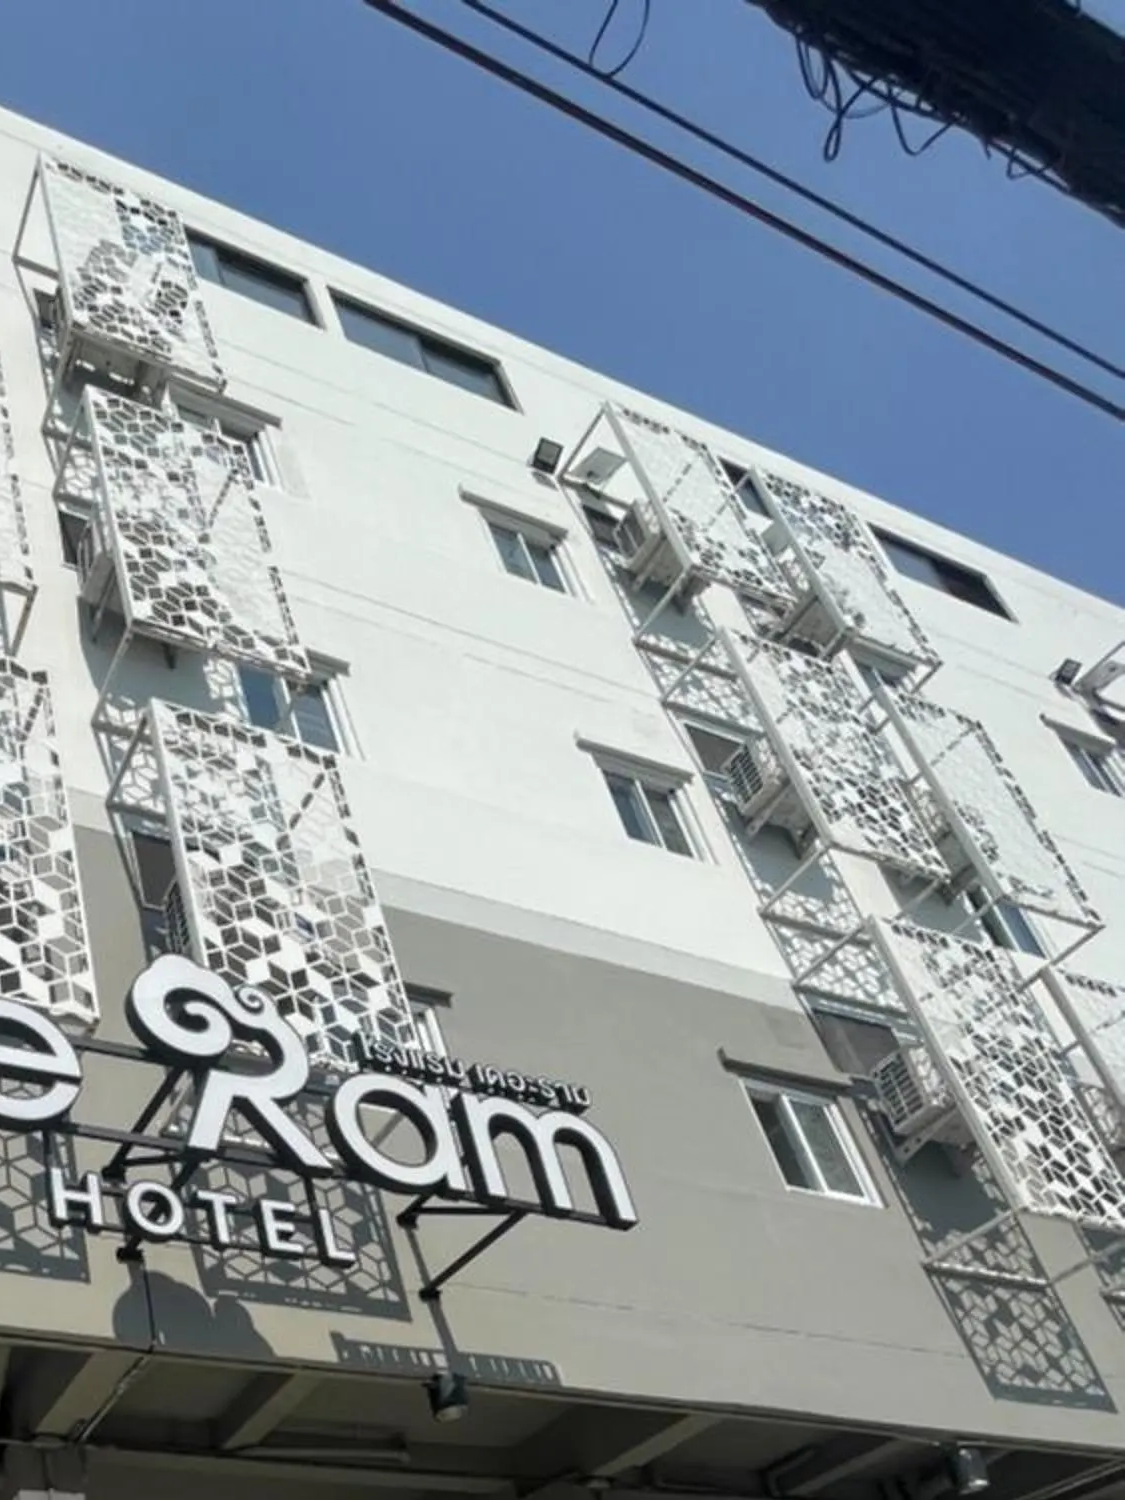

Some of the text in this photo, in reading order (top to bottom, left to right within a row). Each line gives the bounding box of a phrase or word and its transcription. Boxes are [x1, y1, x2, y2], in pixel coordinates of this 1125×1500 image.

[126, 953, 638, 1230] Ram
[359, 1030, 467, 1080] โรงแรม
[50, 1167, 356, 1266] HOTEL
